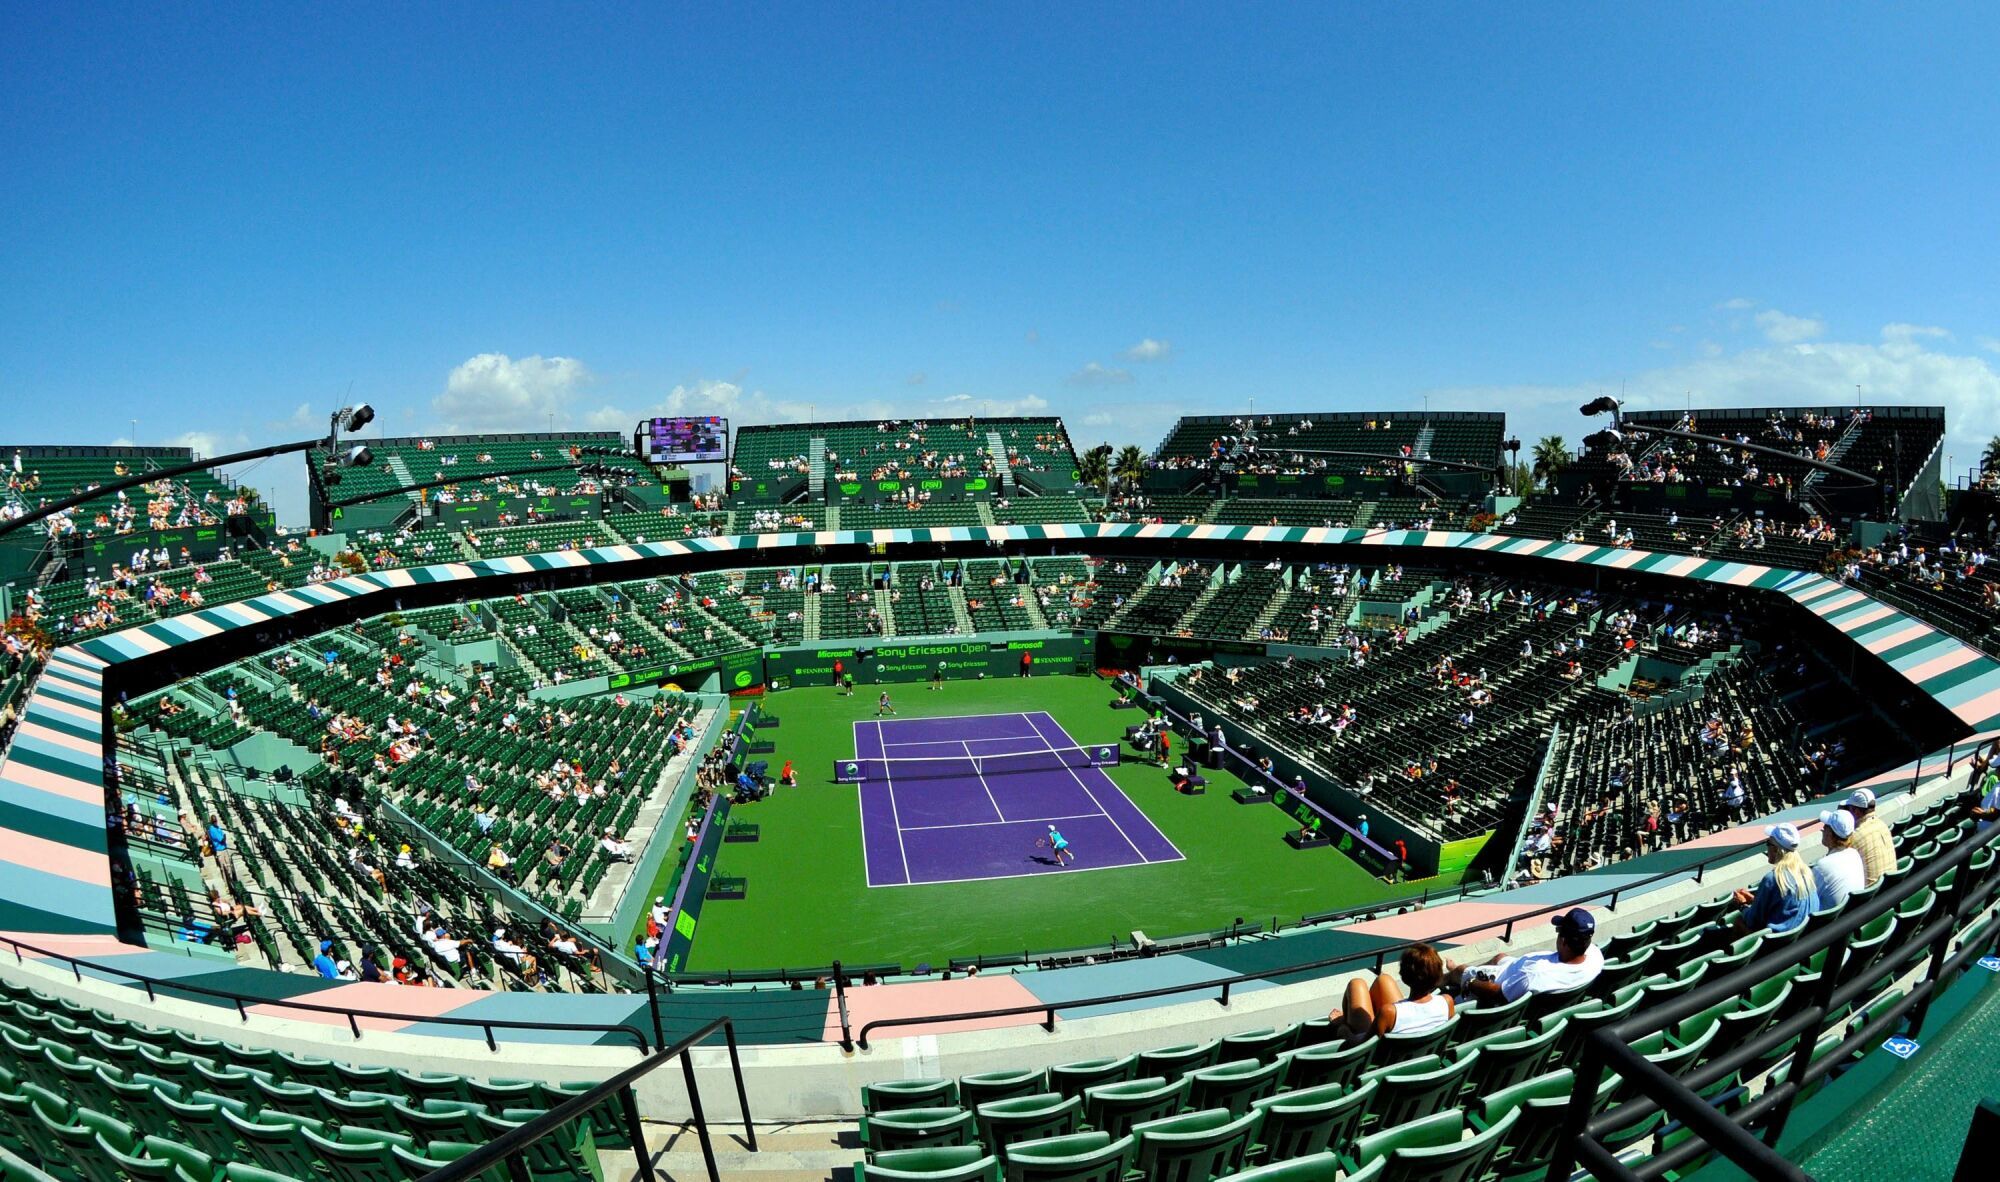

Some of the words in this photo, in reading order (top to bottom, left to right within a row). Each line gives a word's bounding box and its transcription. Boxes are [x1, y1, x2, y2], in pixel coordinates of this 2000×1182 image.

[662, 485, 670, 495] B
[732, 481, 740, 491] B
[333, 507, 343, 519] A
[1008, 641, 1044, 650] Microsoft
[817, 650, 853, 659] Microsoft
[877, 647, 907, 658] Sony
[908, 645, 957, 656] Ericsson
[960, 643, 988, 655] Open
[1040, 656, 1073, 664] STANFORD
[678, 664, 693, 673] Sony
[692, 659, 715, 670] Ericsson
[885, 664, 900, 672] Sony
[948, 661, 963, 669] Sony
